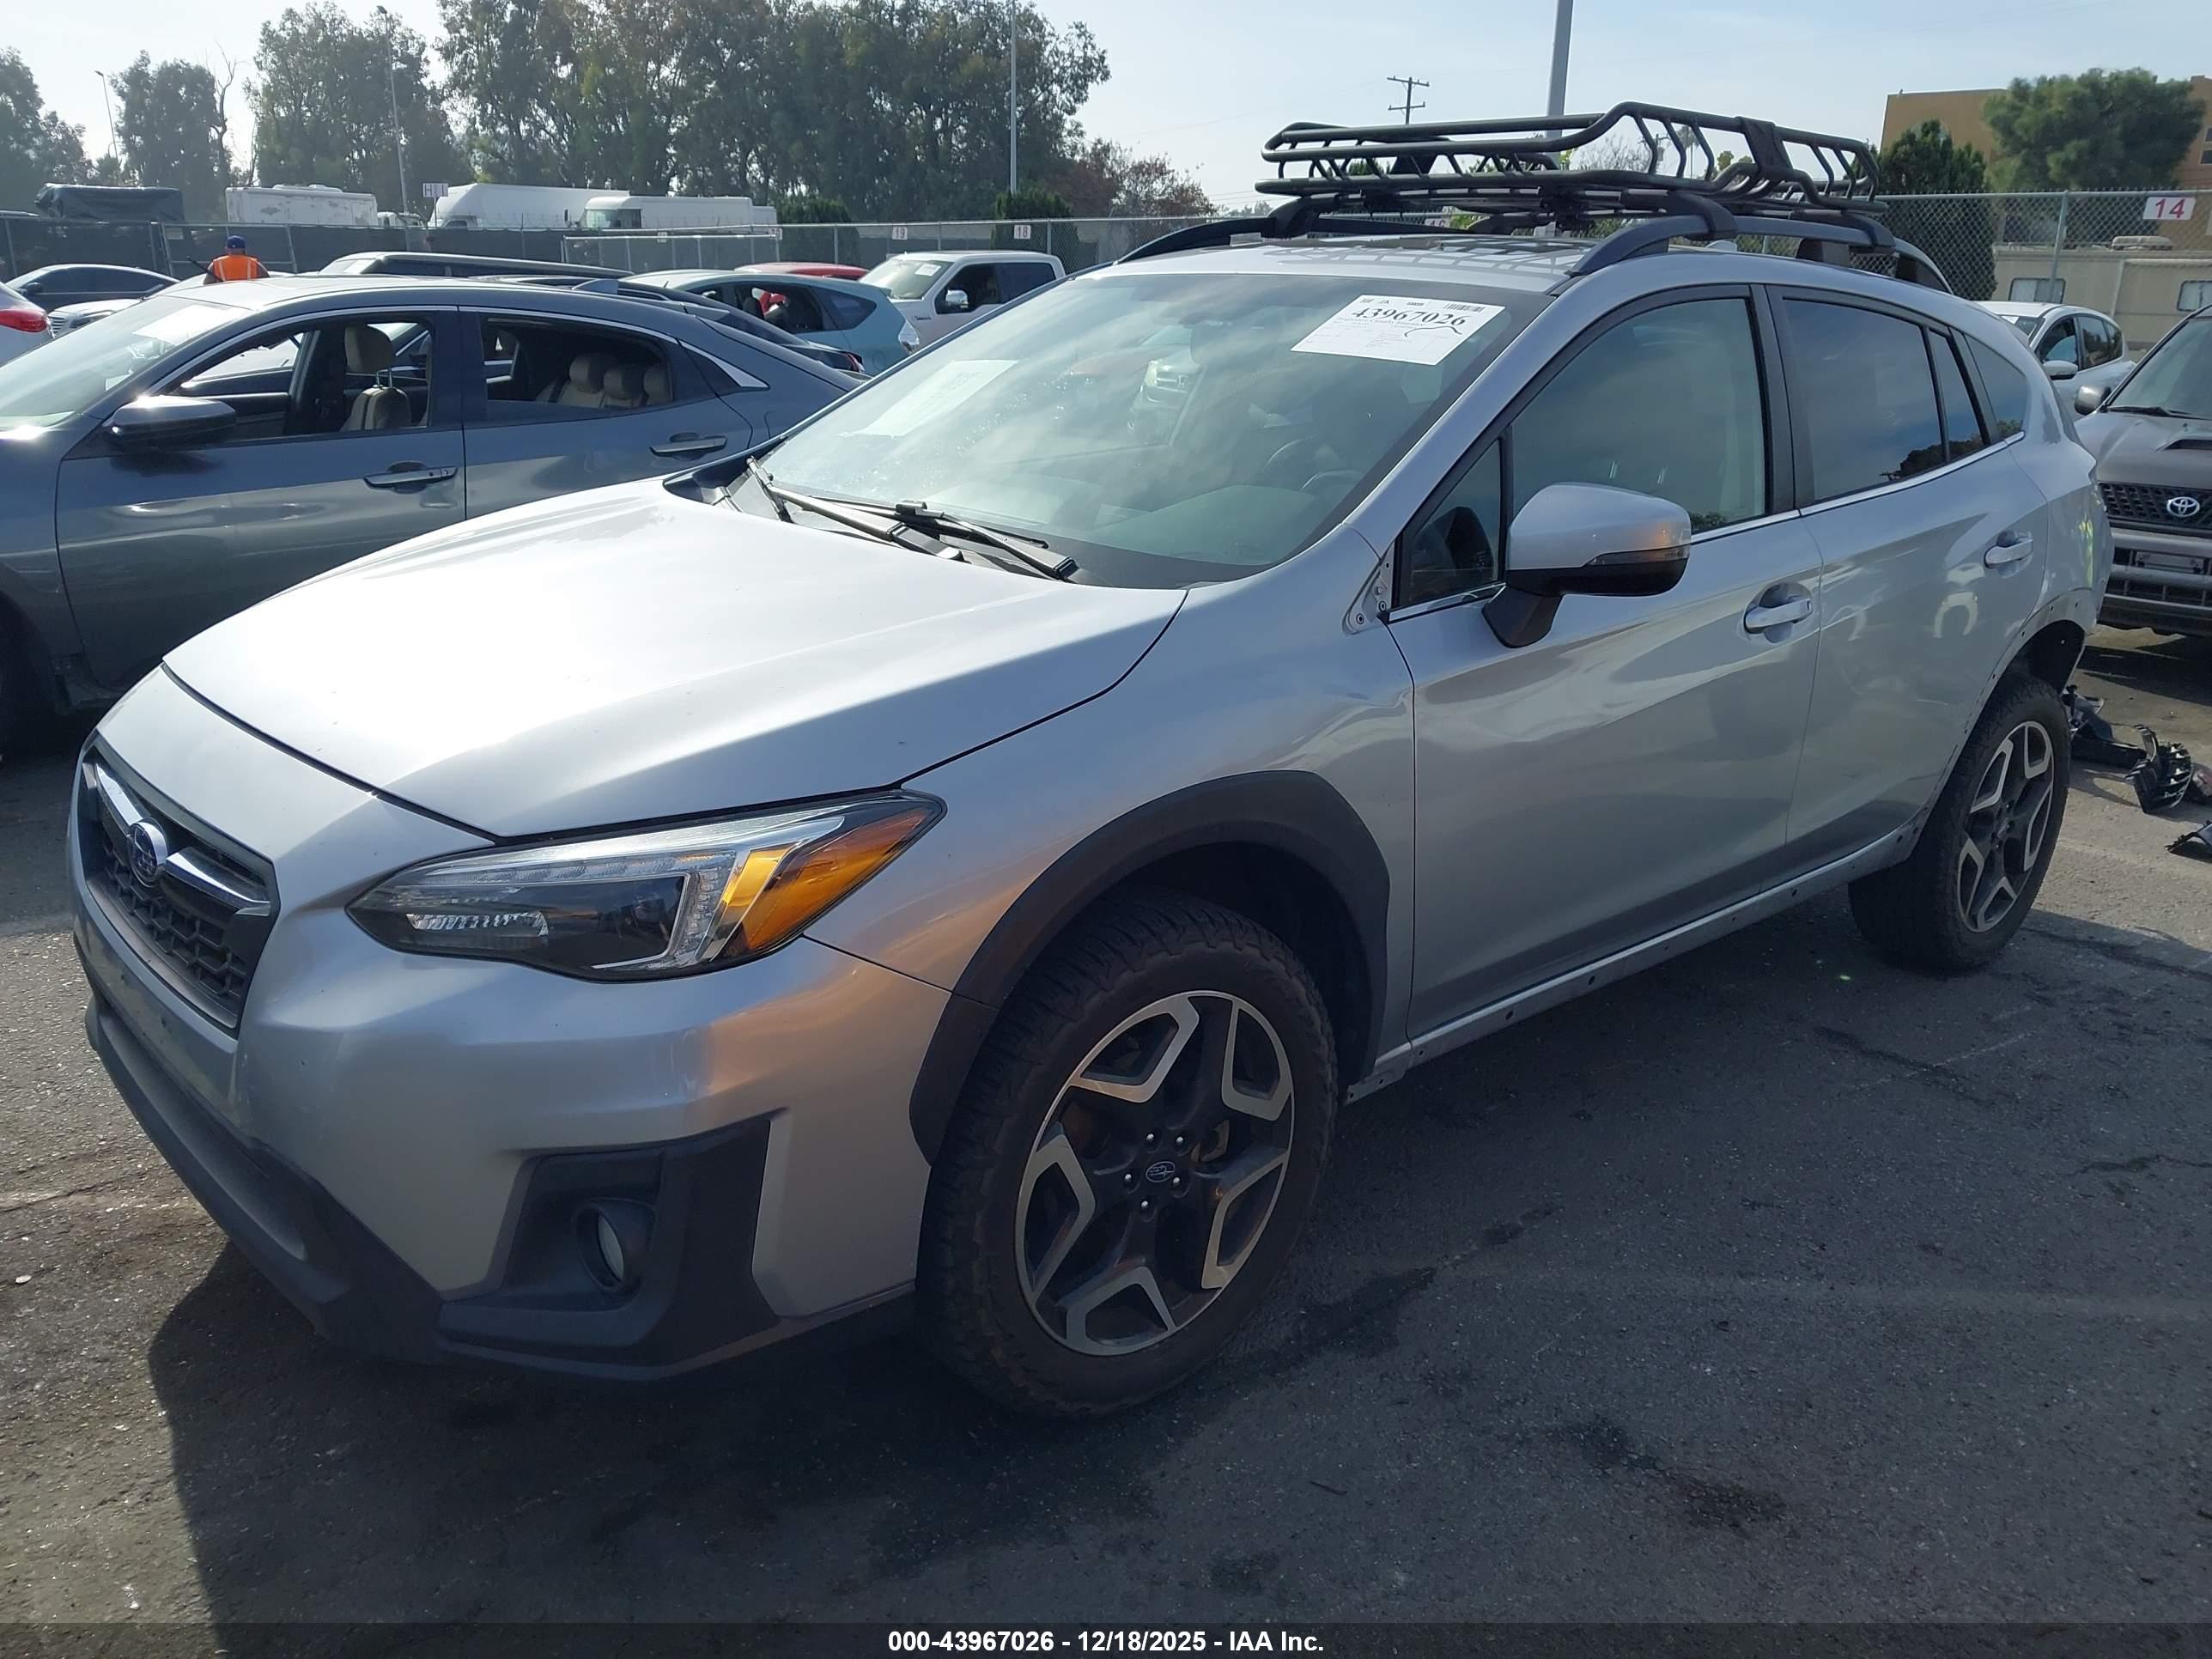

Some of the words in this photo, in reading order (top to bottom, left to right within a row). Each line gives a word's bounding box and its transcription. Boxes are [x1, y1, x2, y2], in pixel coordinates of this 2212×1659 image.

[2154, 198, 2186, 219] 14
[1018, 226, 1028, 238] 18
[1352, 307, 1471, 326] 43967026
